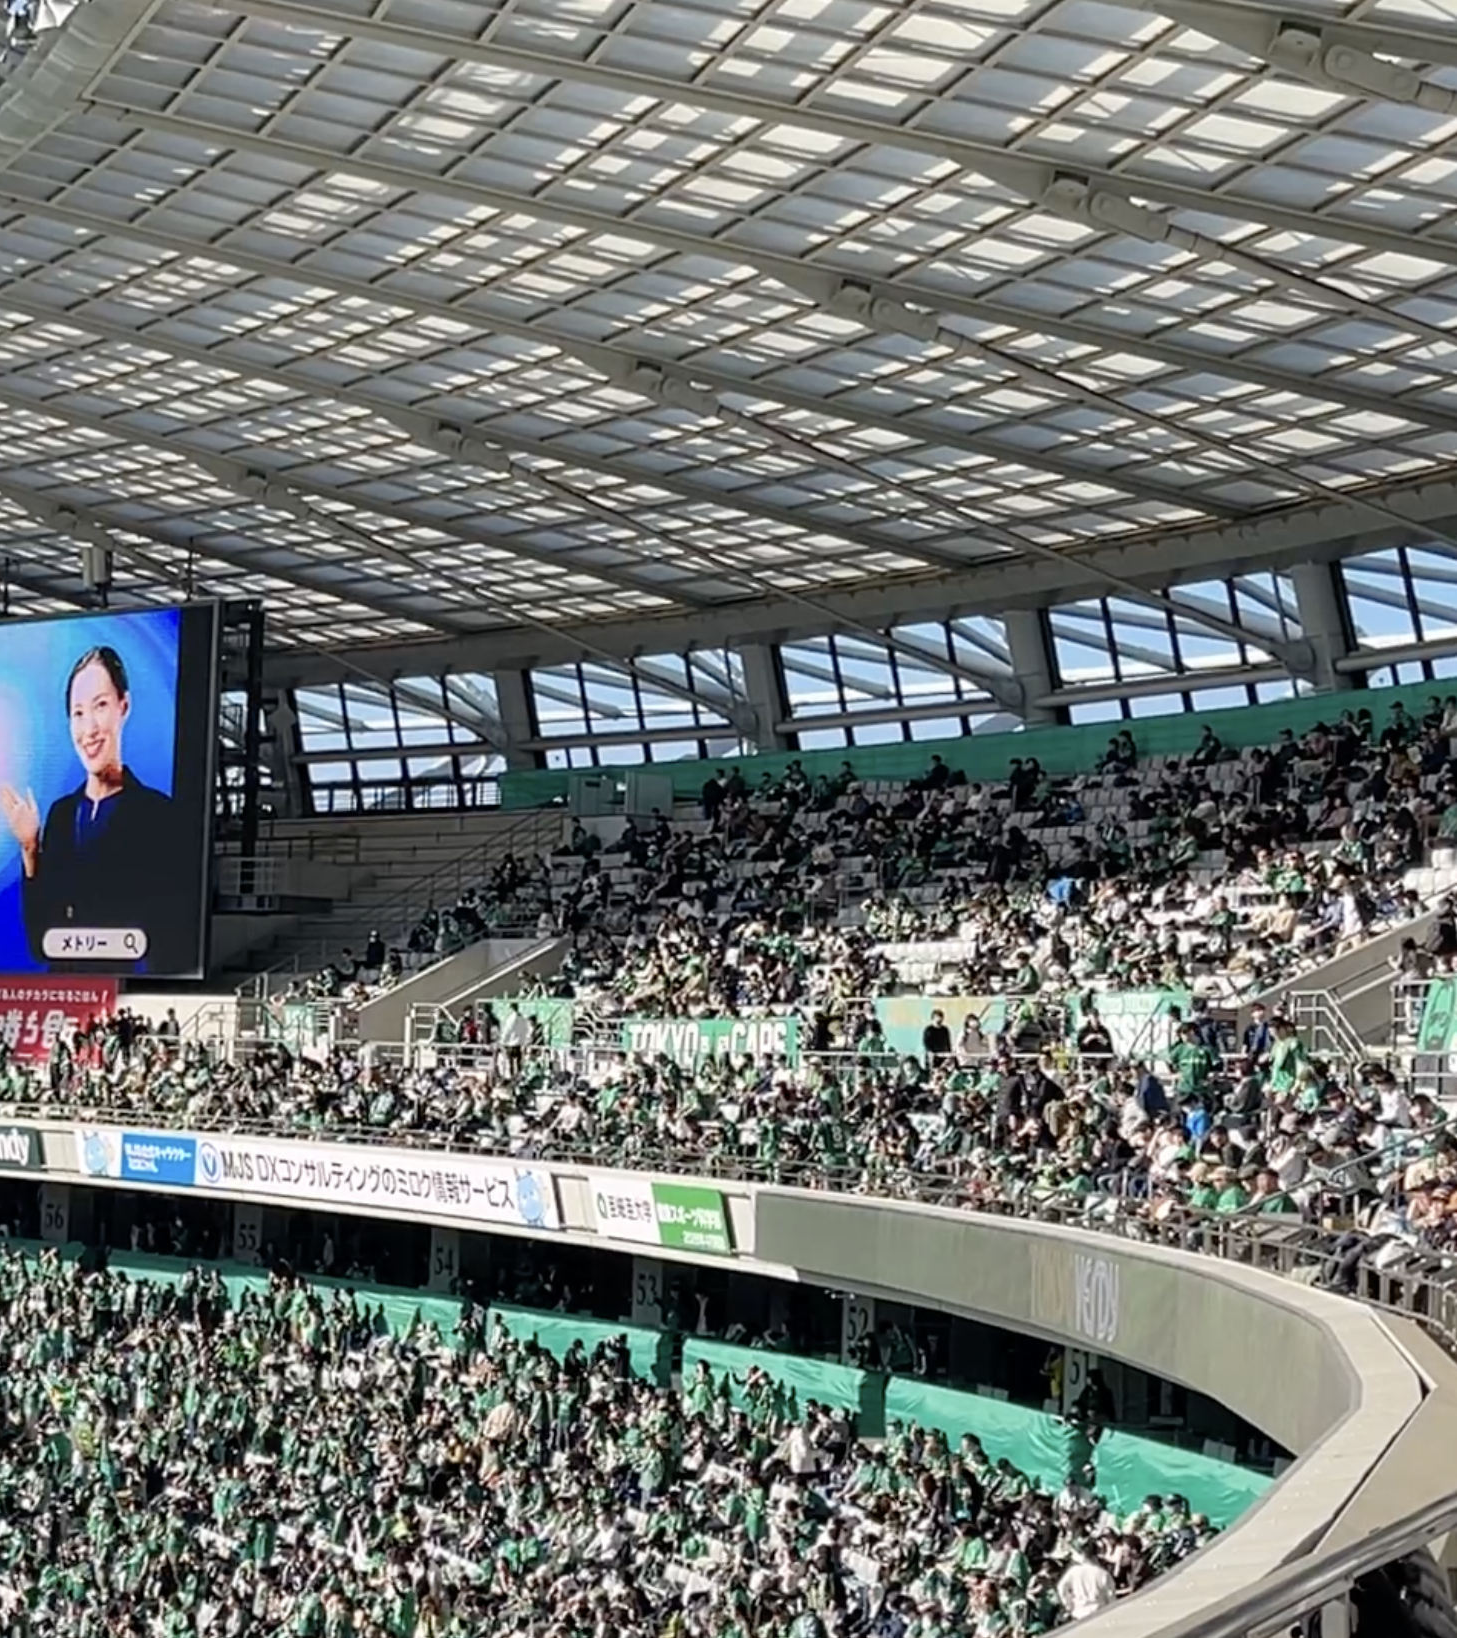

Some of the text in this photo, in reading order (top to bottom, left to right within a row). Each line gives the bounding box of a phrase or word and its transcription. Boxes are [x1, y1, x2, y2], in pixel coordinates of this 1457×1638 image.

[62, 936, 107, 951] メトリー
[628, 1022, 700, 1068] TOKYO
[221, 1151, 254, 1181] MJS
[46, 1203, 64, 1229] 56
[434, 1240, 455, 1276] 54
[636, 1272, 657, 1307] 53
[846, 1306, 869, 1341] 52
